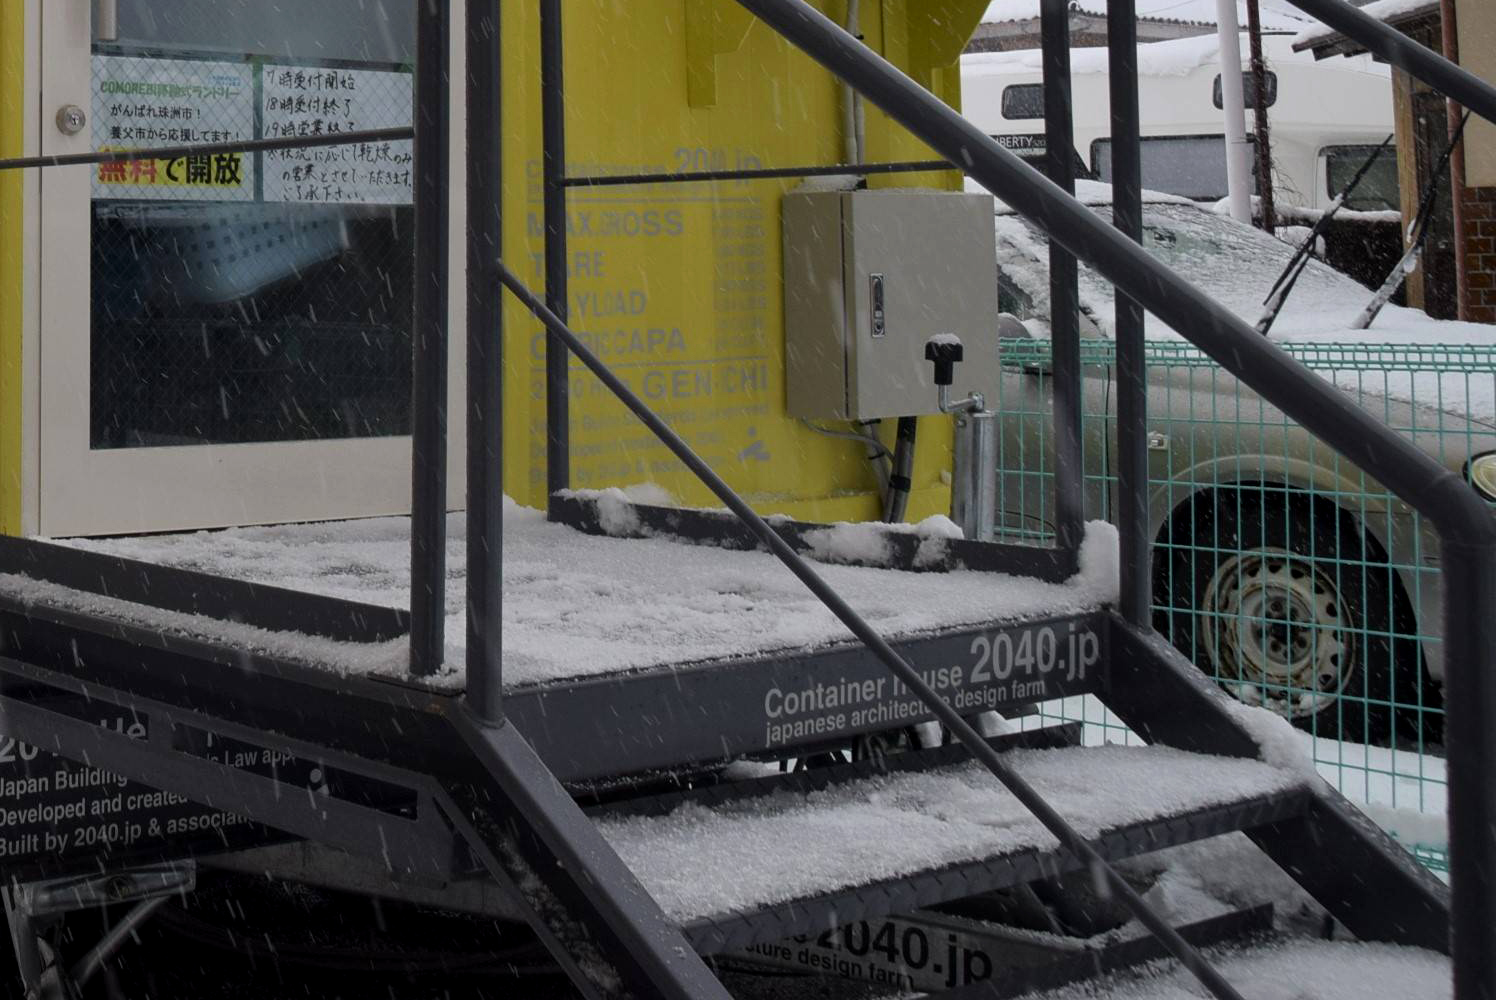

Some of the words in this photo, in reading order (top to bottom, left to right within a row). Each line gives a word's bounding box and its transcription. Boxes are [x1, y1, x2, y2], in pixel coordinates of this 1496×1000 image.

[764, 676, 886, 720] Container
[969, 622, 1100, 685] 2040.jp
[765, 711, 847, 749] japanese
[954, 685, 1008, 710] design
[1011, 678, 1047, 701] farm
[224, 749, 257, 768] Law
[54, 767, 128, 792] Building
[90, 793, 123, 816] and
[44, 831, 69, 856] by
[74, 822, 142, 847] 2040.jp
[147, 817, 164, 837] &
[797, 949, 863, 978] design
[867, 964, 915, 990] farm
